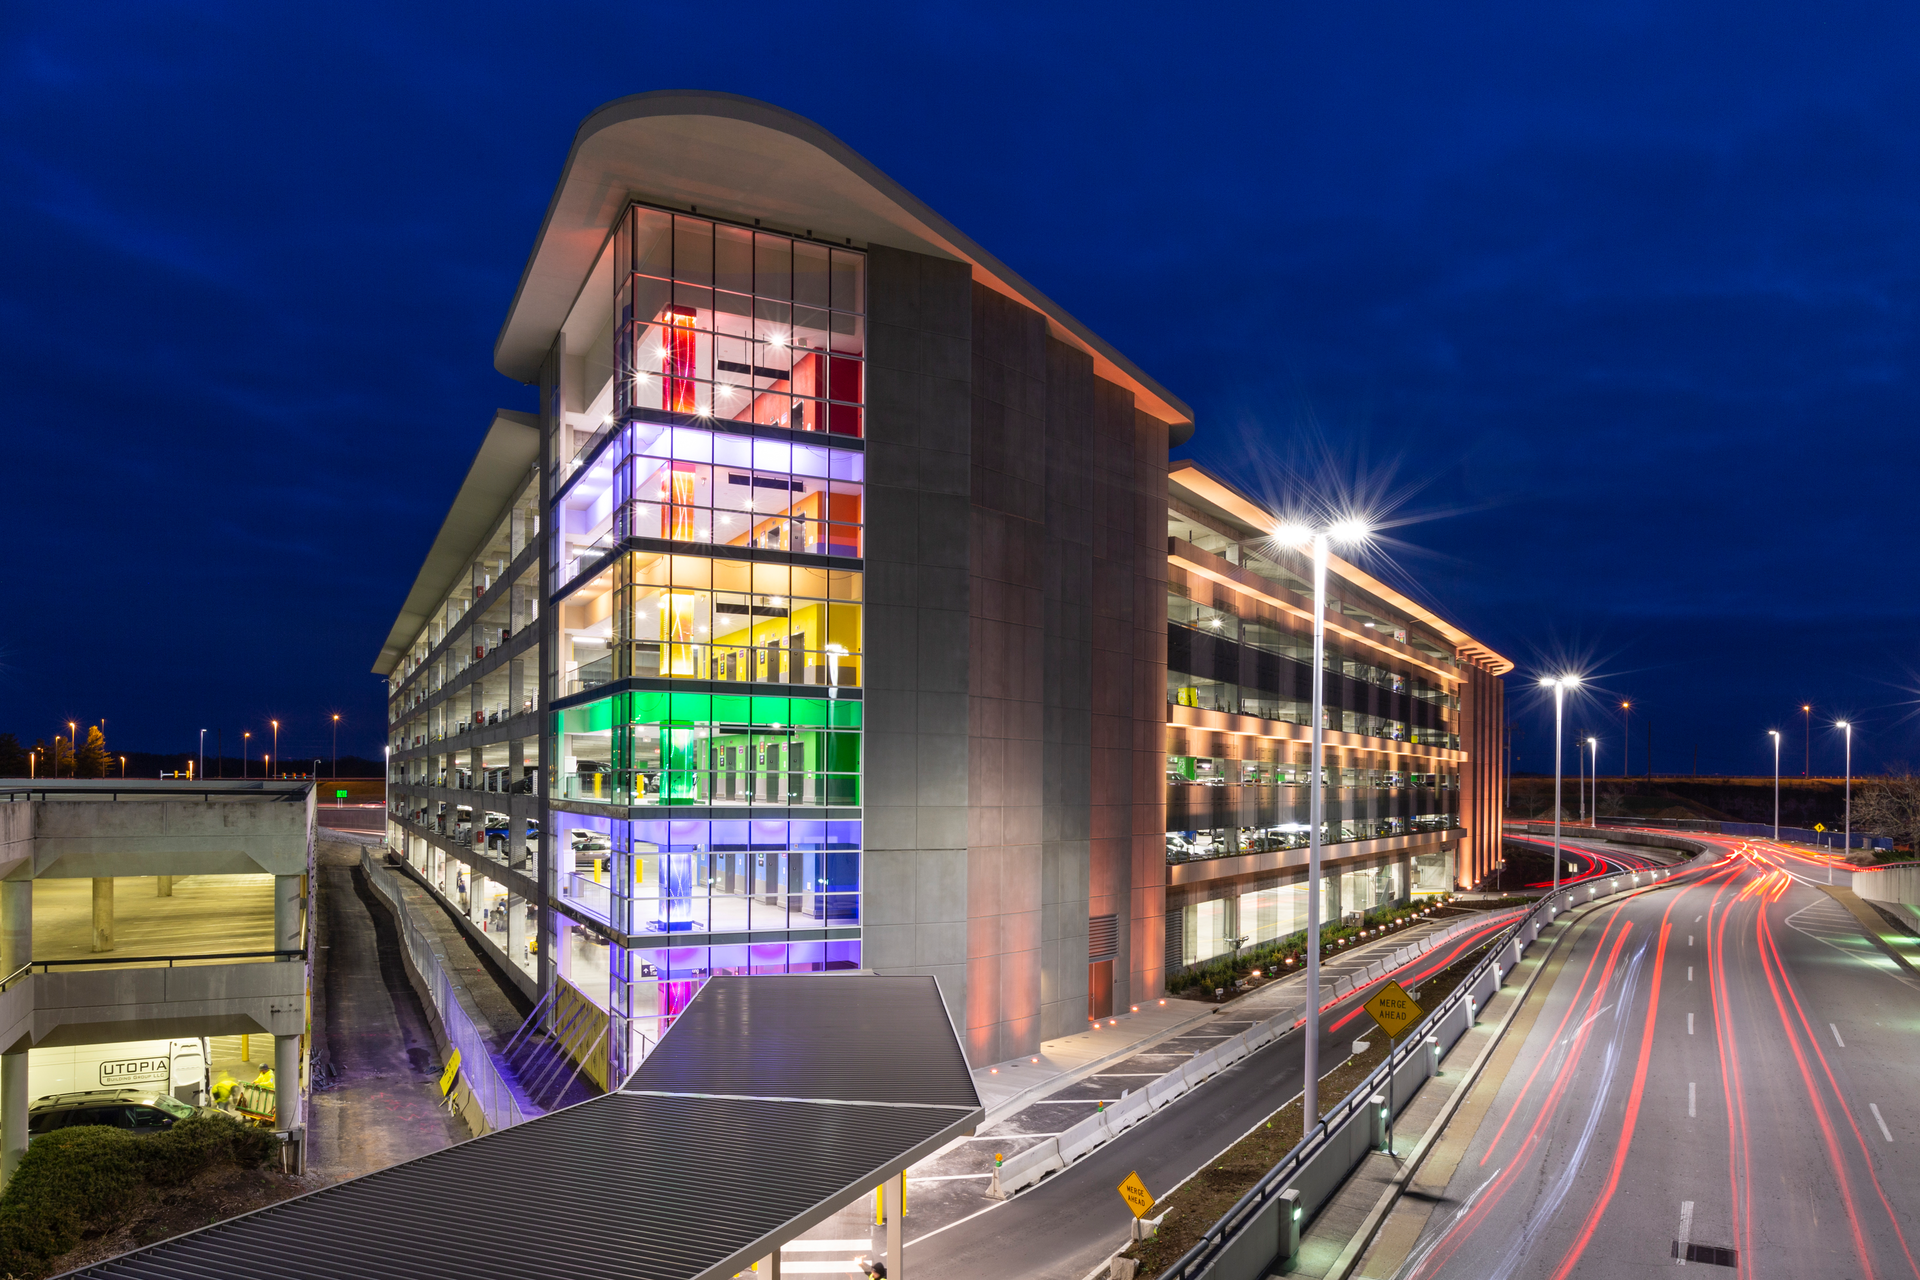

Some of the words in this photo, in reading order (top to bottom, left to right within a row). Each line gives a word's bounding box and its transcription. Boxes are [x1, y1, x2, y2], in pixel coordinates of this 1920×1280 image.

[1379, 998, 1407, 1009] MERGE
[1379, 1010, 1407, 1021] AHEAD
[104, 1060, 167, 1075] UTOPIA
[1126, 1184, 1145, 1198] MERGE
[1127, 1194, 1146, 1207] AHEAD
